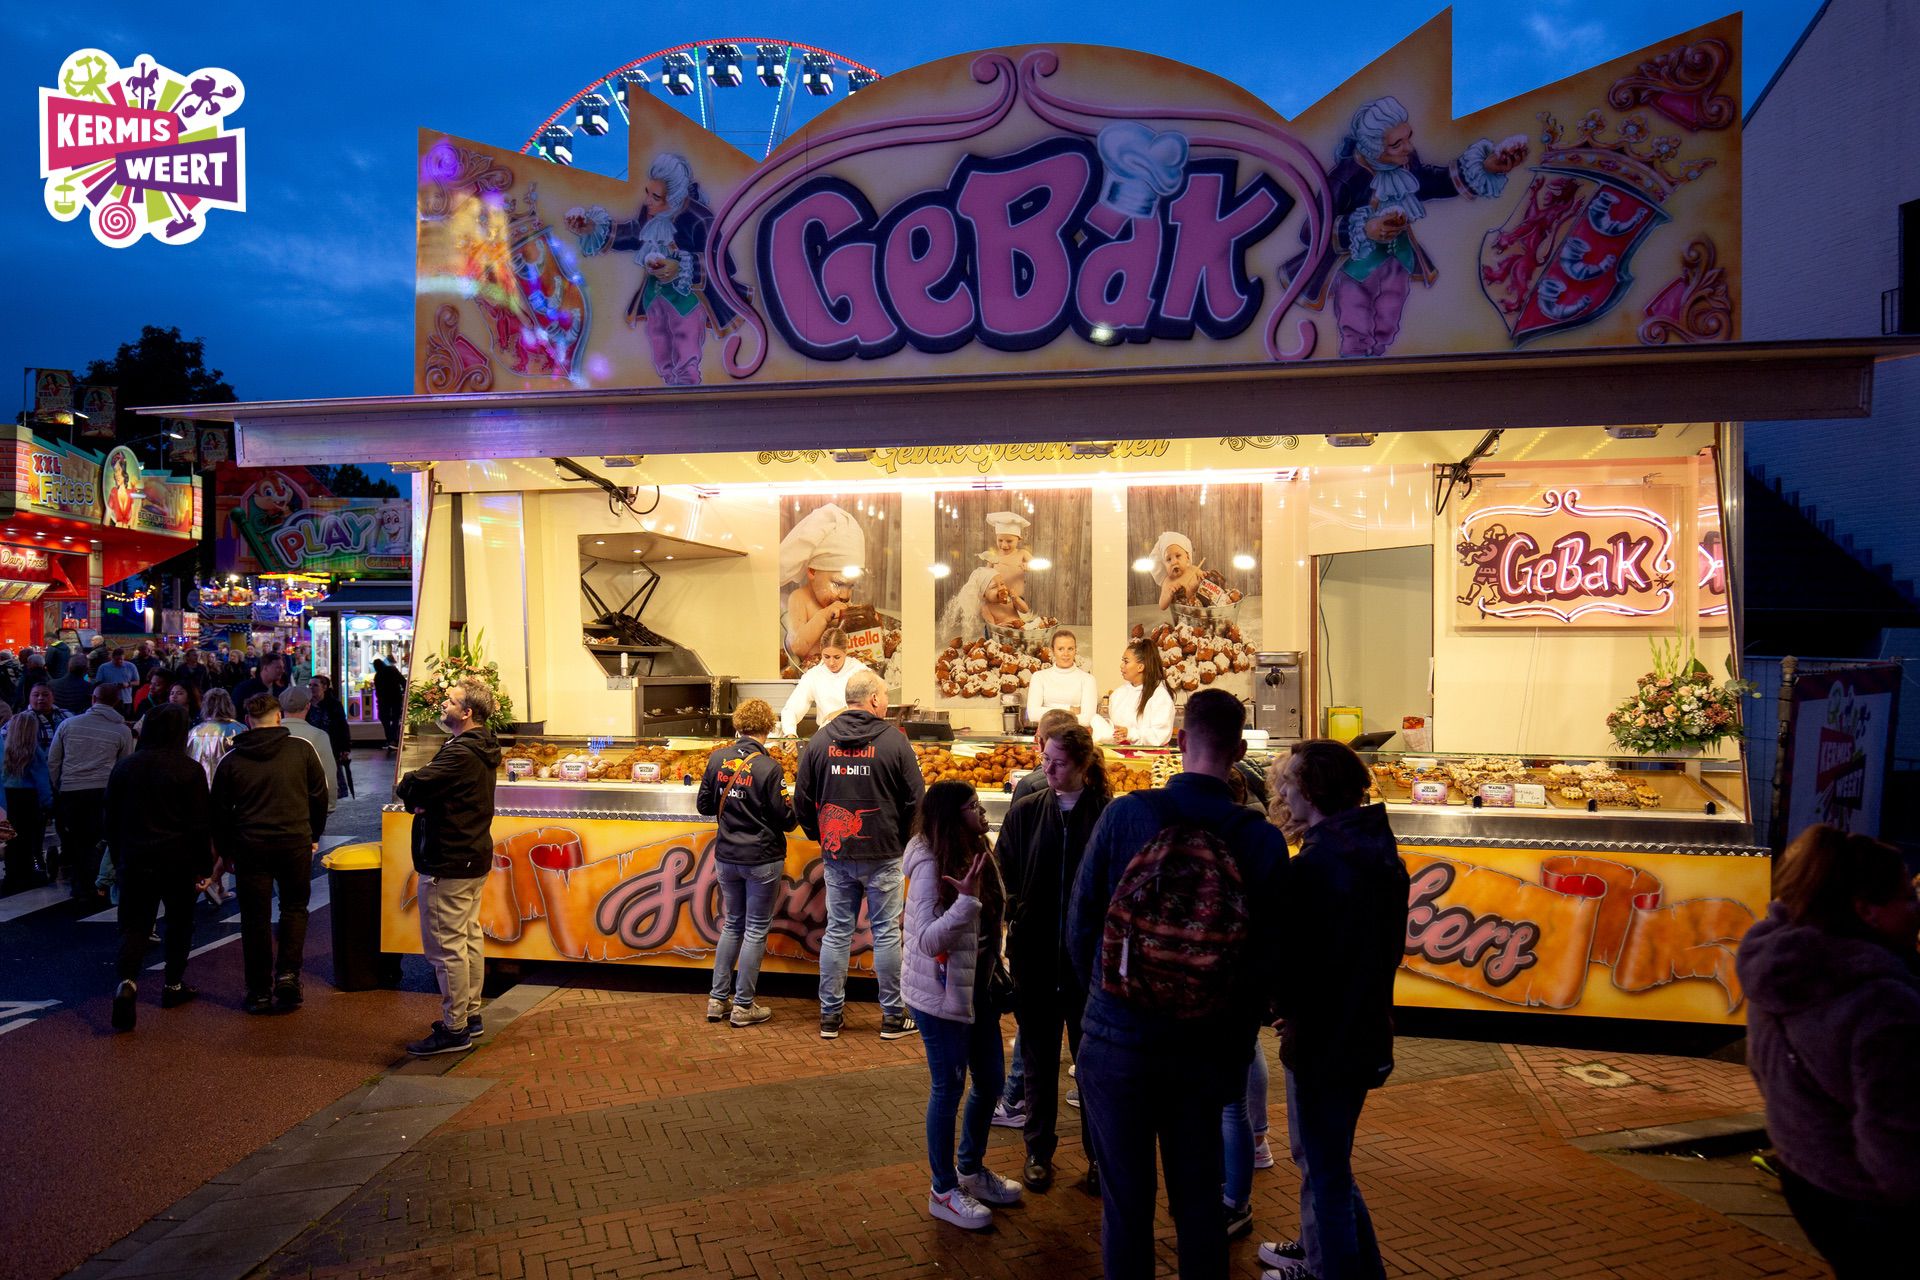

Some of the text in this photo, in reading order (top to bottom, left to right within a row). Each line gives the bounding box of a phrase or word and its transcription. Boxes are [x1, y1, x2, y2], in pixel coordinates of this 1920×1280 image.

[33, 454, 61, 474] XXL
[40, 475, 93, 505] Frites
[272, 509, 376, 567] PLAY
[2, 550, 25, 572] Dairy
[847, 630, 880, 649] utella
[717, 771, 734, 784] Re
[831, 765, 859, 775] Mobil
